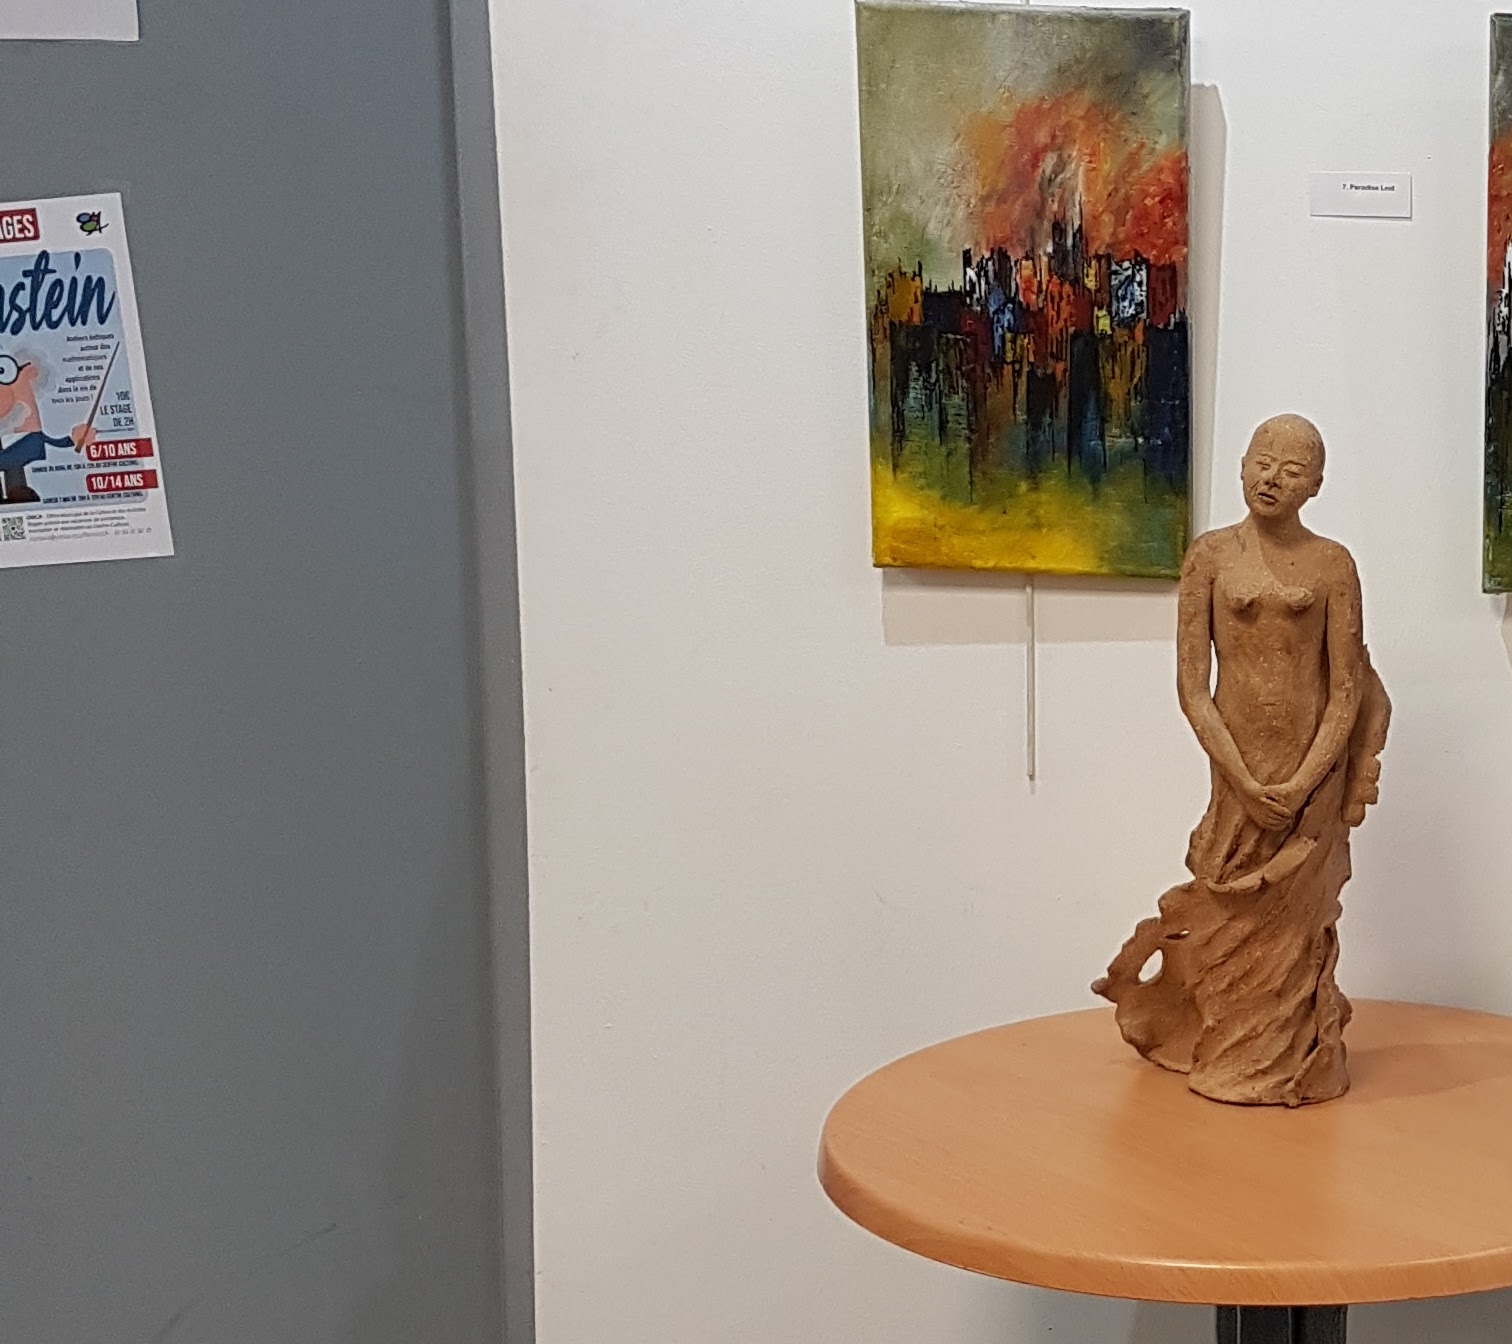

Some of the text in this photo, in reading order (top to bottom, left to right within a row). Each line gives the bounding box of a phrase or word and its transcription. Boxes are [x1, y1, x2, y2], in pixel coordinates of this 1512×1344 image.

[0, 214, 35, 240] GES
[90, 442, 137, 458] 6/10 ANS
[91, 473, 144, 490] 10/14 ANS
